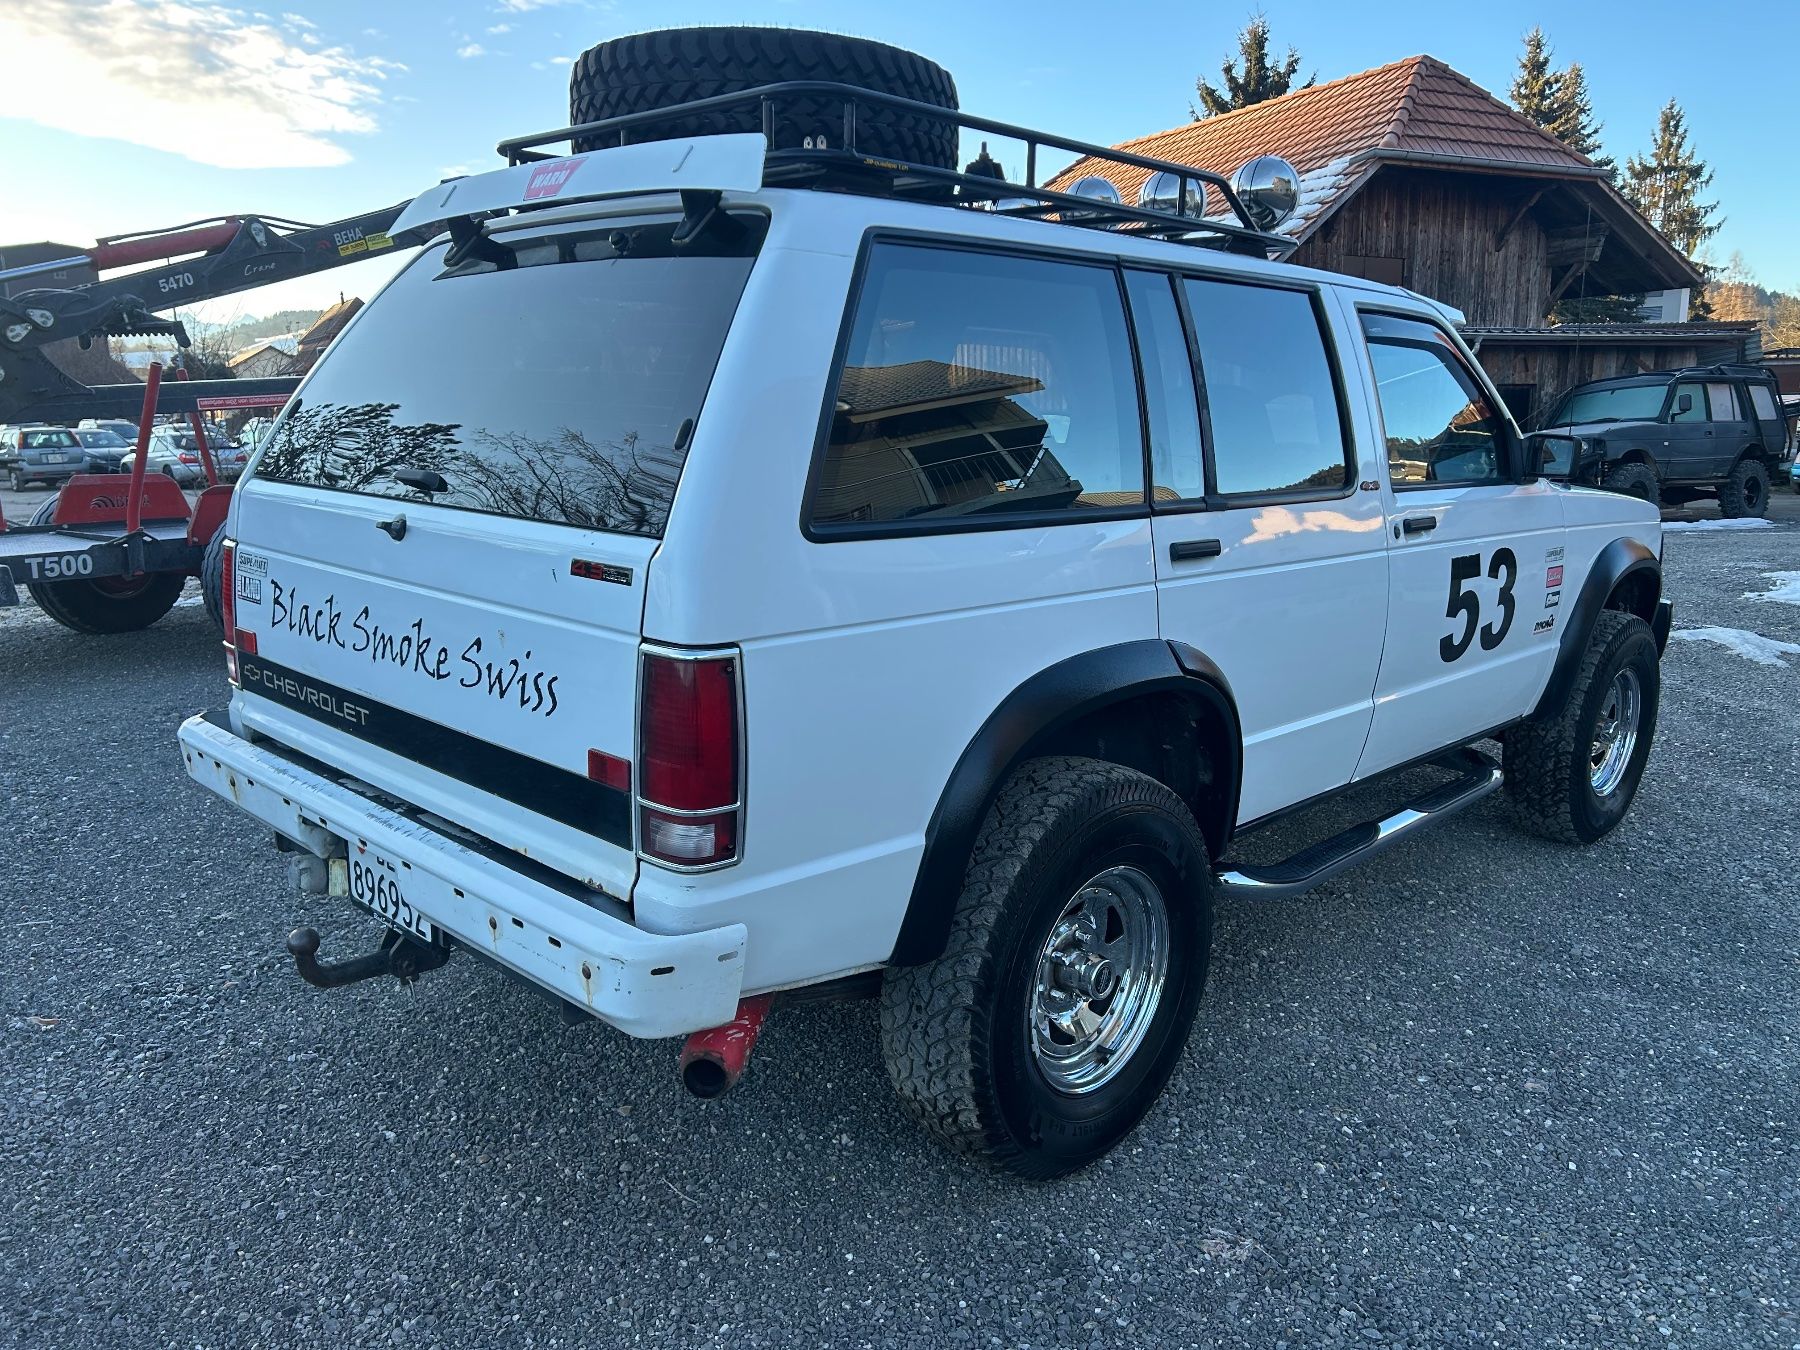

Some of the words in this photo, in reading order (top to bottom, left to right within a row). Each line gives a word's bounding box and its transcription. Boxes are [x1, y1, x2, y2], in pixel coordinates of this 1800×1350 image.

[531, 169, 571, 188] WARN
[334, 227, 363, 246] BEHA
[244, 262, 276, 276] Crane
[158, 272, 194, 293] 5470
[25, 553, 93, 579] T500
[1439, 547, 1517, 663] 53
[270, 579, 345, 649] Black
[352, 605, 451, 681] Smoke
[459, 637, 558, 717] Swiss
[263, 669, 370, 726] CHEVROLET
